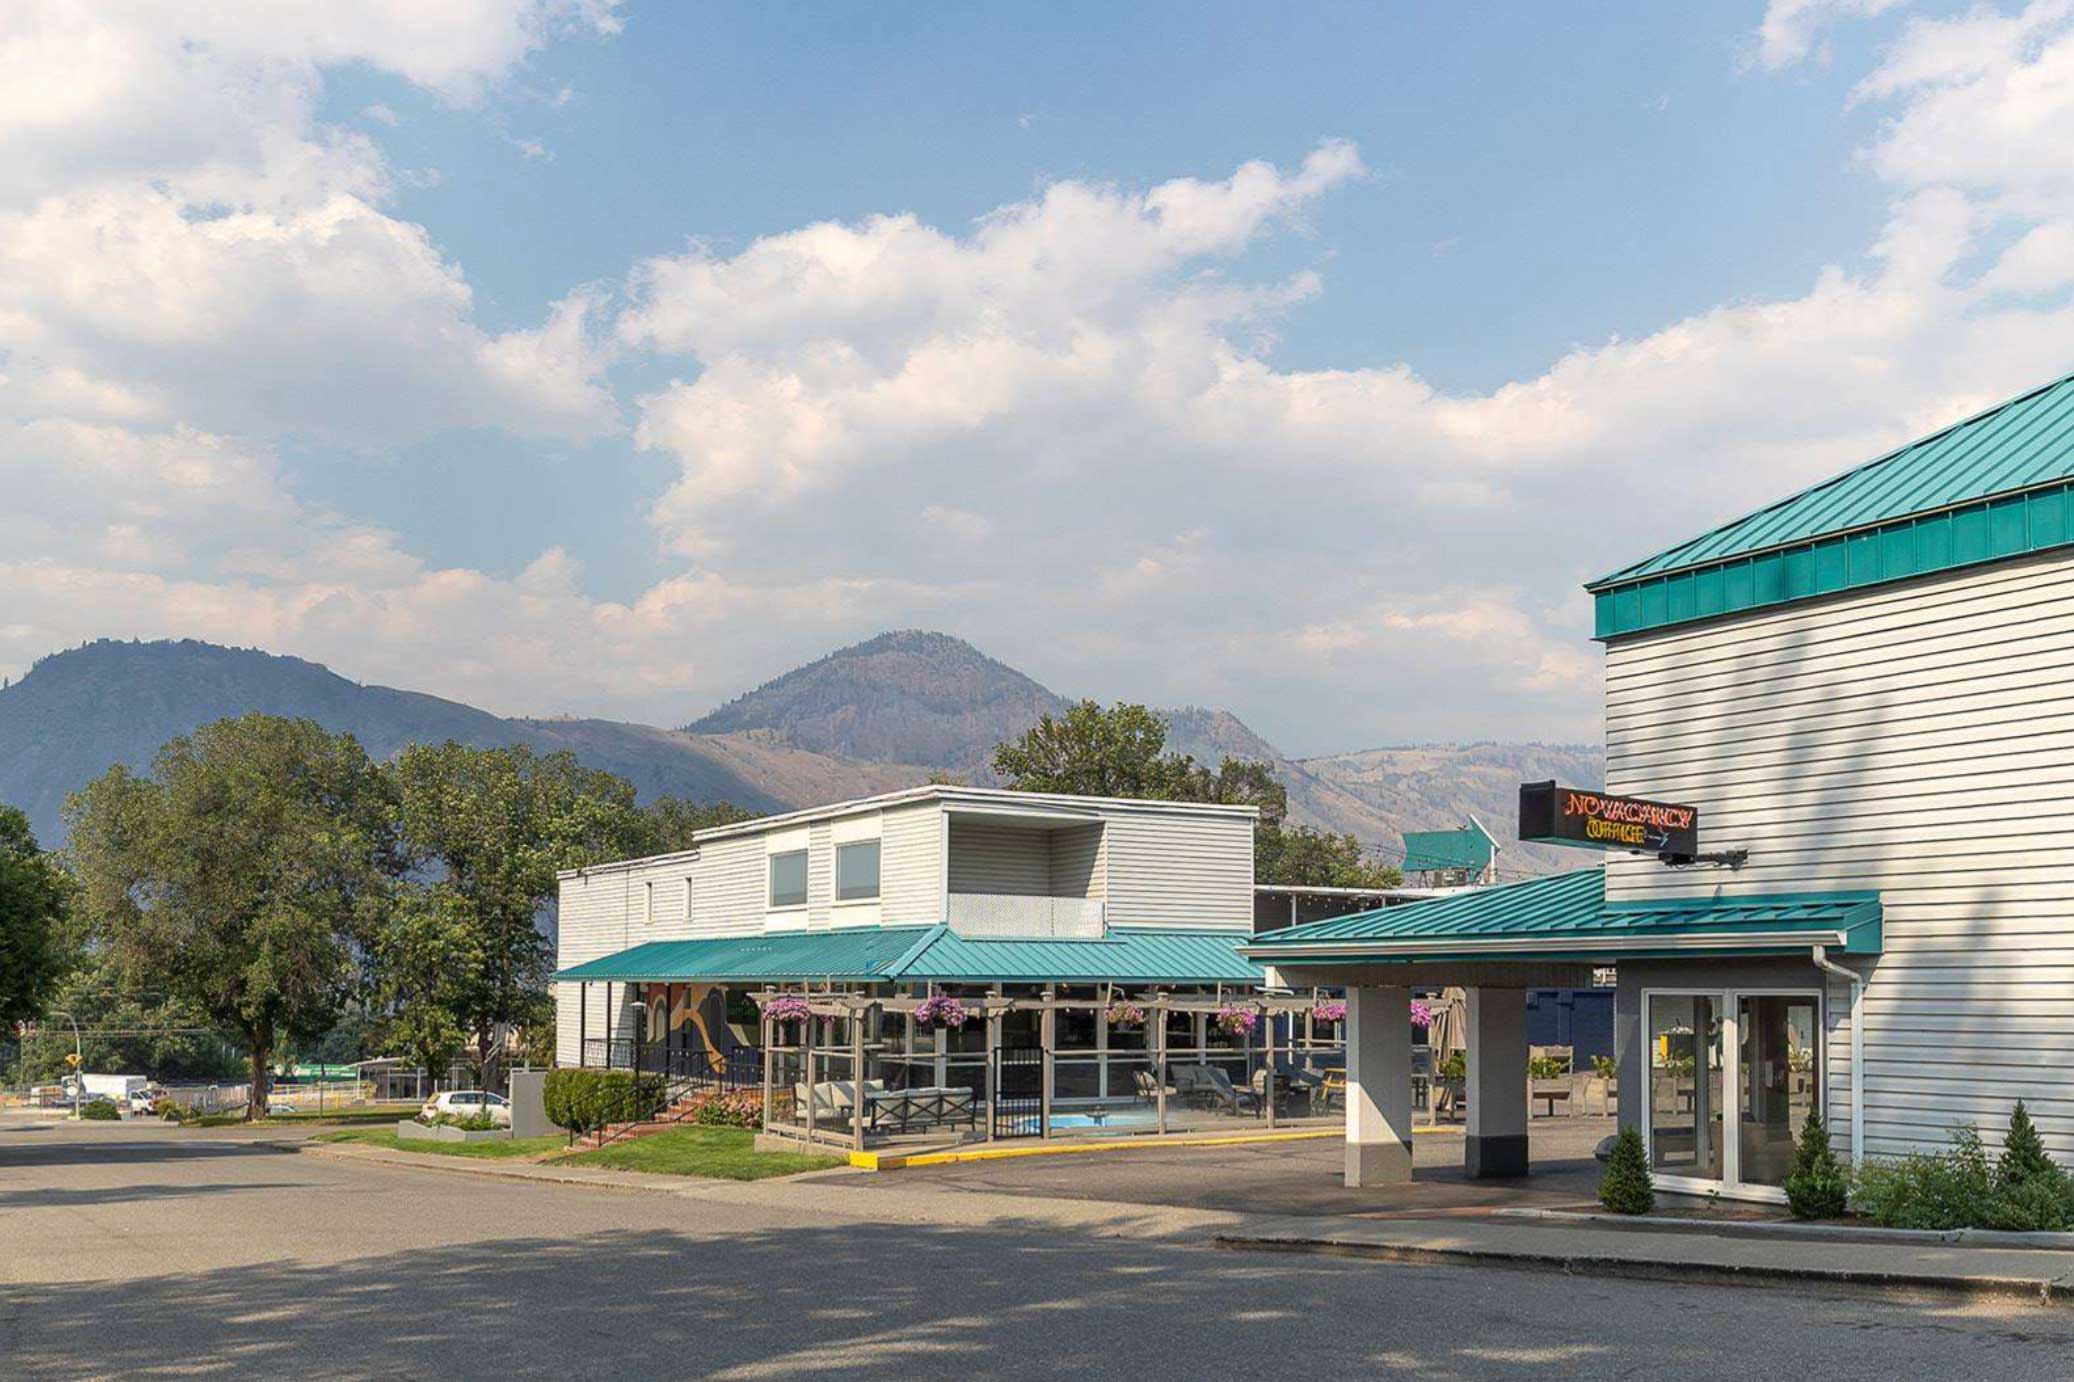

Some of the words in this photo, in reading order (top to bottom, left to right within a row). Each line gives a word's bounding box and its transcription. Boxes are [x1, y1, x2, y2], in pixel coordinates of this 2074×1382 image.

[1564, 793, 1600, 816] NO
[1600, 799, 1693, 829] VACANCY
[1586, 819, 1645, 844] OFFICE
